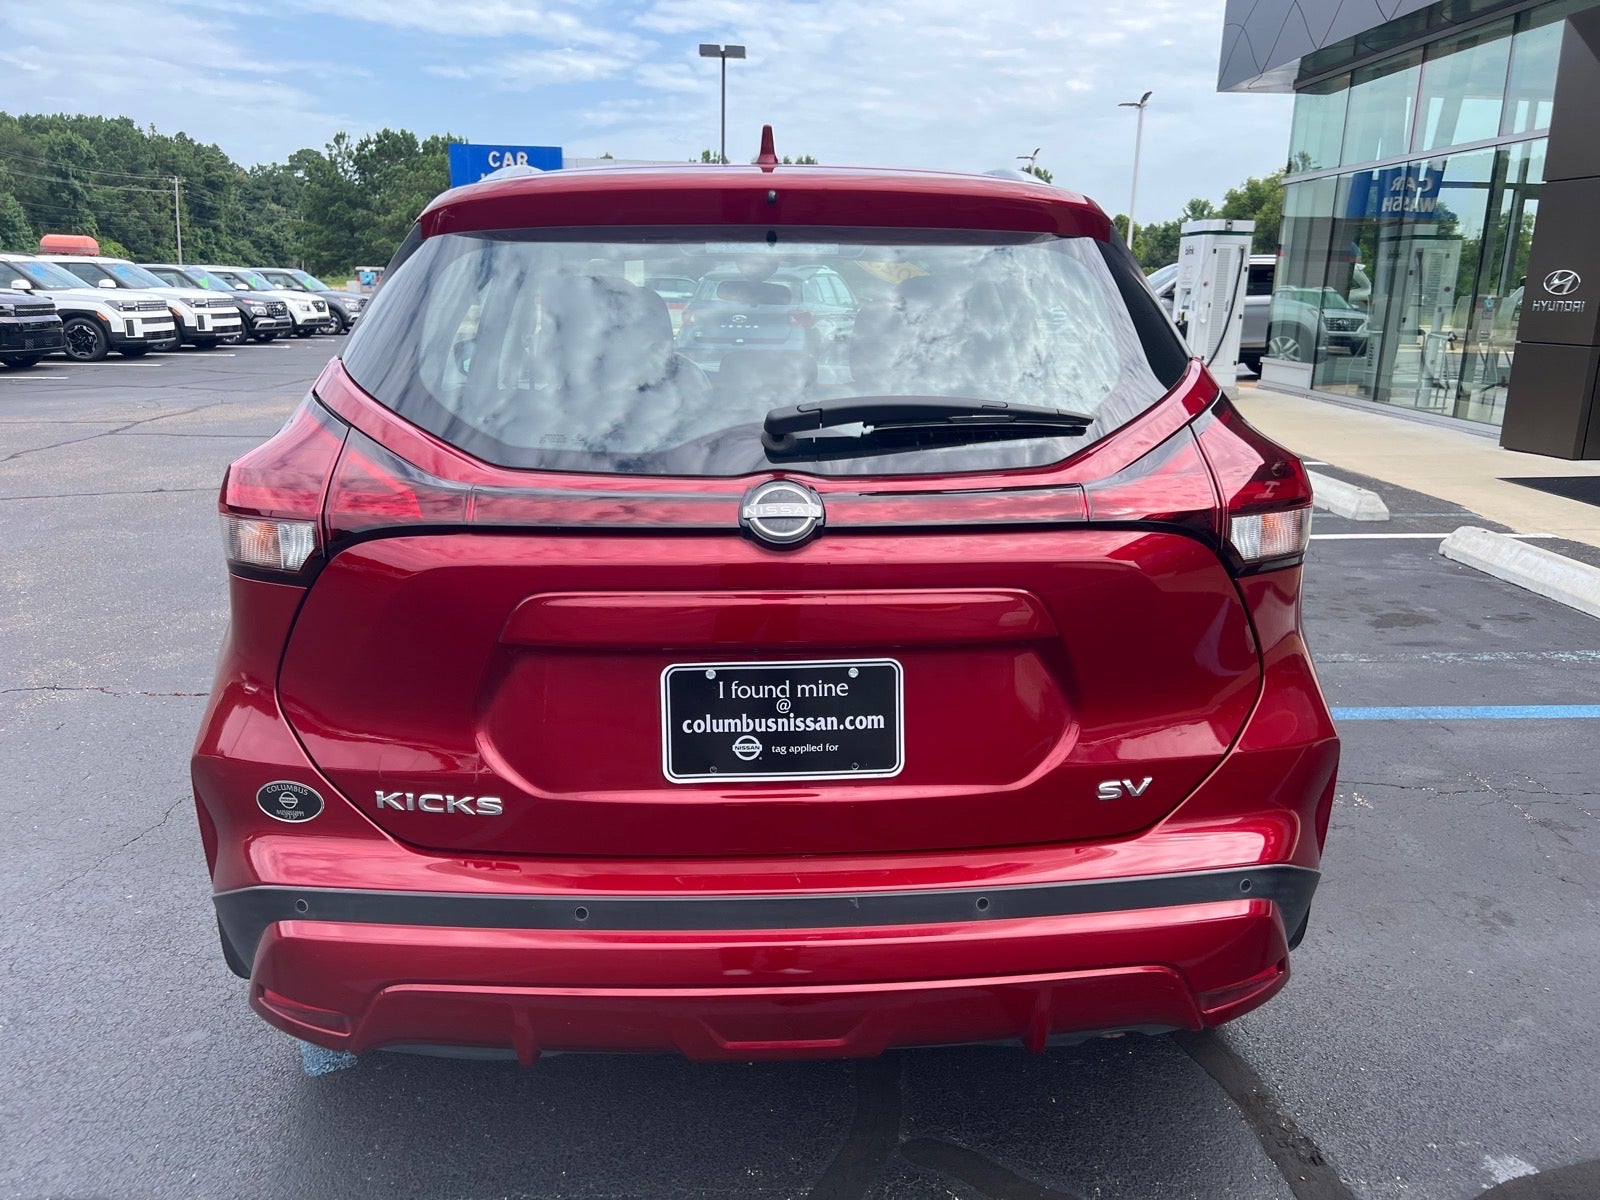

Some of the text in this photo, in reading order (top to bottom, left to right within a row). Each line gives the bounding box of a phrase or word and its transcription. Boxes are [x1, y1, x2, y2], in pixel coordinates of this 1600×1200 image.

[488, 151, 528, 168] CAR
[1532, 300, 1585, 312] HYUNDAI
[744, 505, 821, 517] NISSAN
[718, 680, 849, 699] I found mine
[776, 698, 791, 713] @
[682, 713, 885, 734] columbusnissan.com
[771, 743, 839, 755] tag applied for
[266, 784, 308, 796] COLUMBUS
[1097, 777, 1153, 800] SV
[375, 790, 503, 816] KICKS
